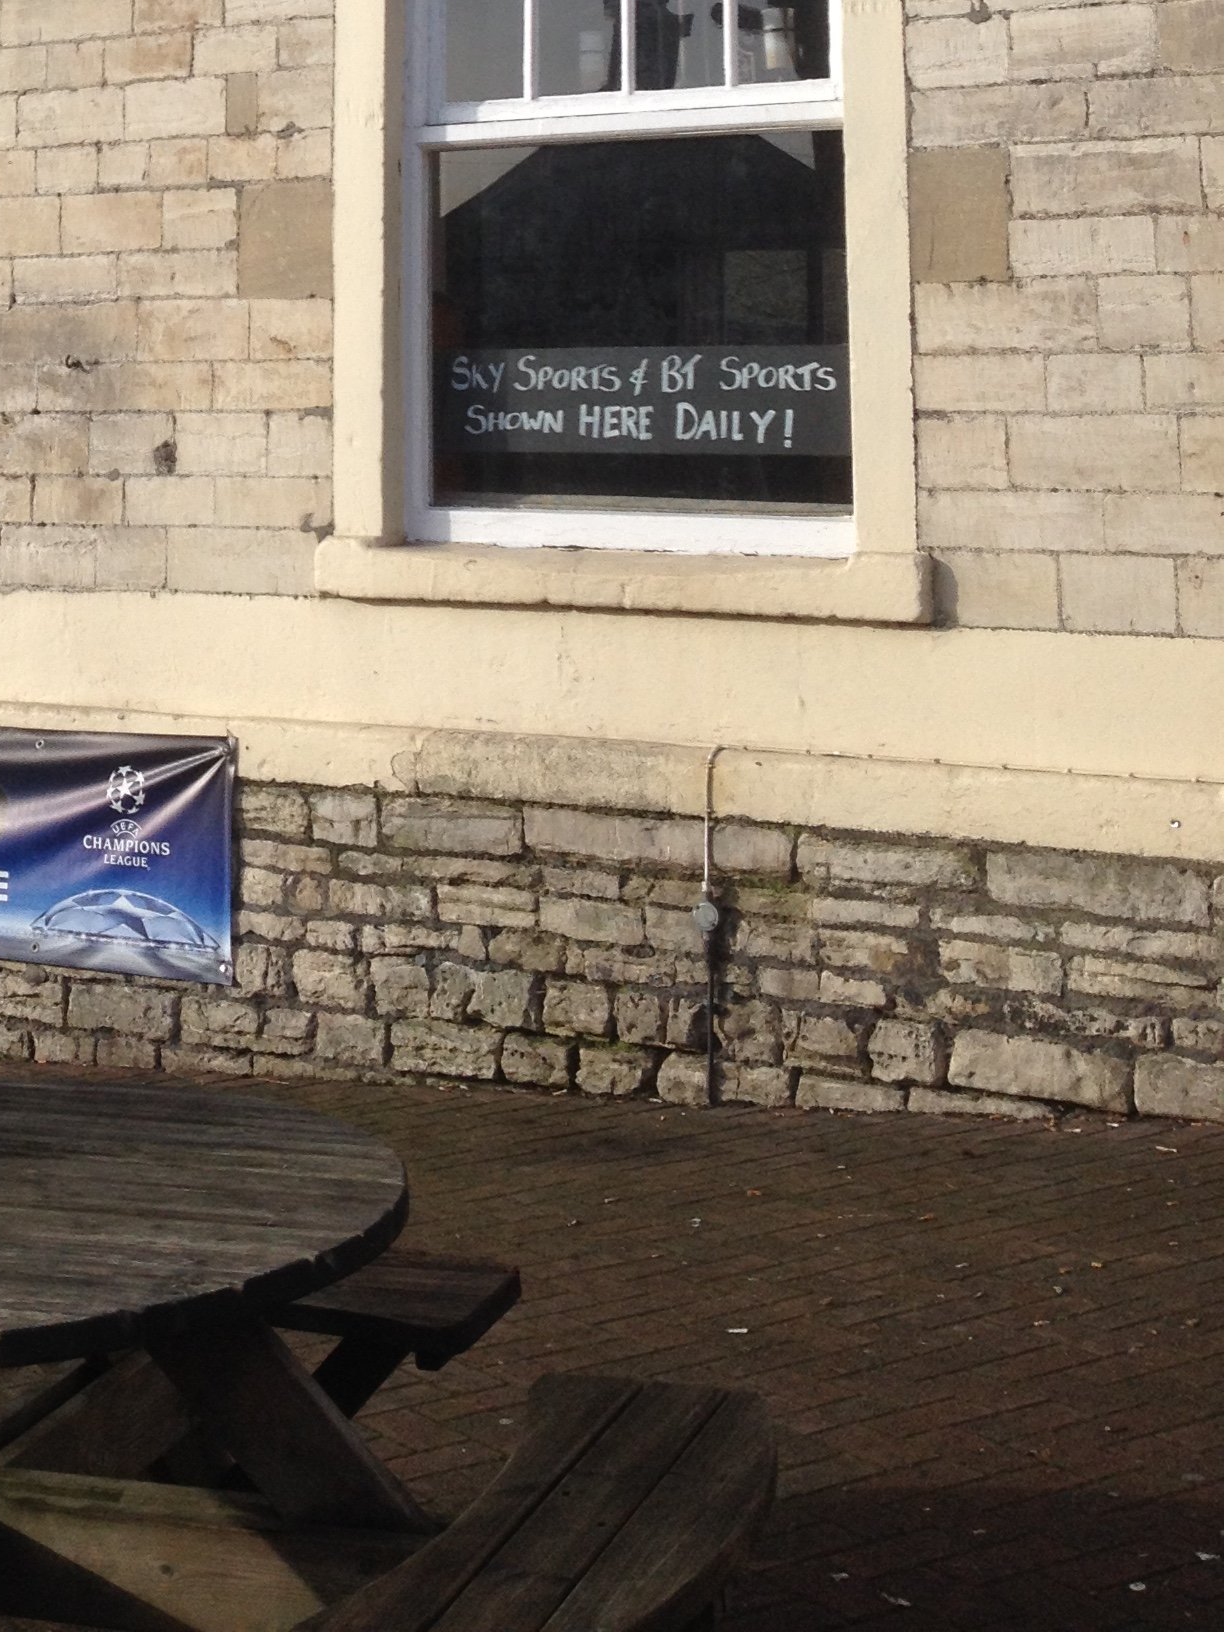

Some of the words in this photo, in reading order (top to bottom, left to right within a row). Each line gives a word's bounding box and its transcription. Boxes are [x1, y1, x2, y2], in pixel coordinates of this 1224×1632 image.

[451, 356, 505, 393] SKY
[513, 355, 622, 392] SPORTS
[661, 354, 702, 393] BT
[719, 356, 837, 391] SPORTS
[464, 404, 564, 435] SHOWN
[578, 403, 654, 441] HERE
[111, 821, 139, 836] UEFA
[83, 834, 170, 856] CHAMPIONS
[103, 854, 148, 868] LEAGUE
